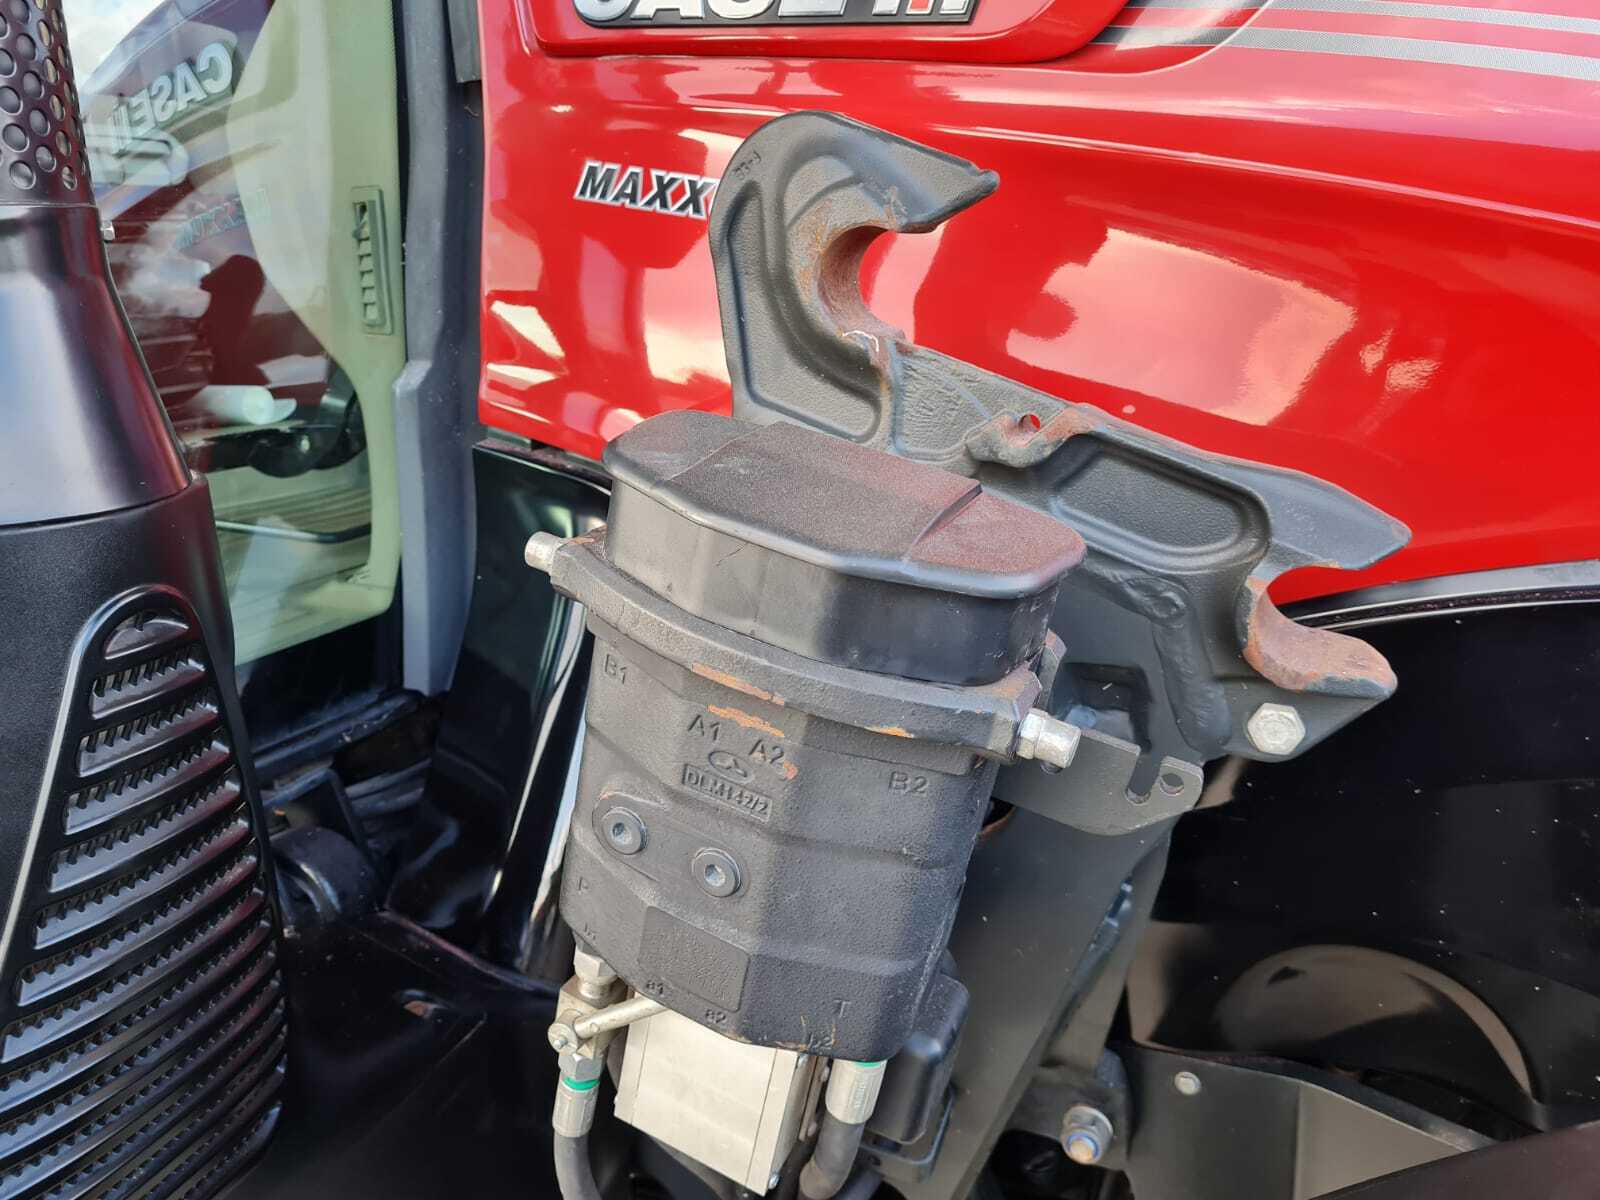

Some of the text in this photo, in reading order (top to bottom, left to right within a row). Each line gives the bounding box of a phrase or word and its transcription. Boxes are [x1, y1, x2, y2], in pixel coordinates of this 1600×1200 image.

[575, 161, 719, 219] MAXX
[604, 654, 628, 685] B1
[688, 714, 720, 741] A1
[748, 739, 785, 764] A2
[889, 771, 929, 794] B2
[834, 999, 852, 1020] T
